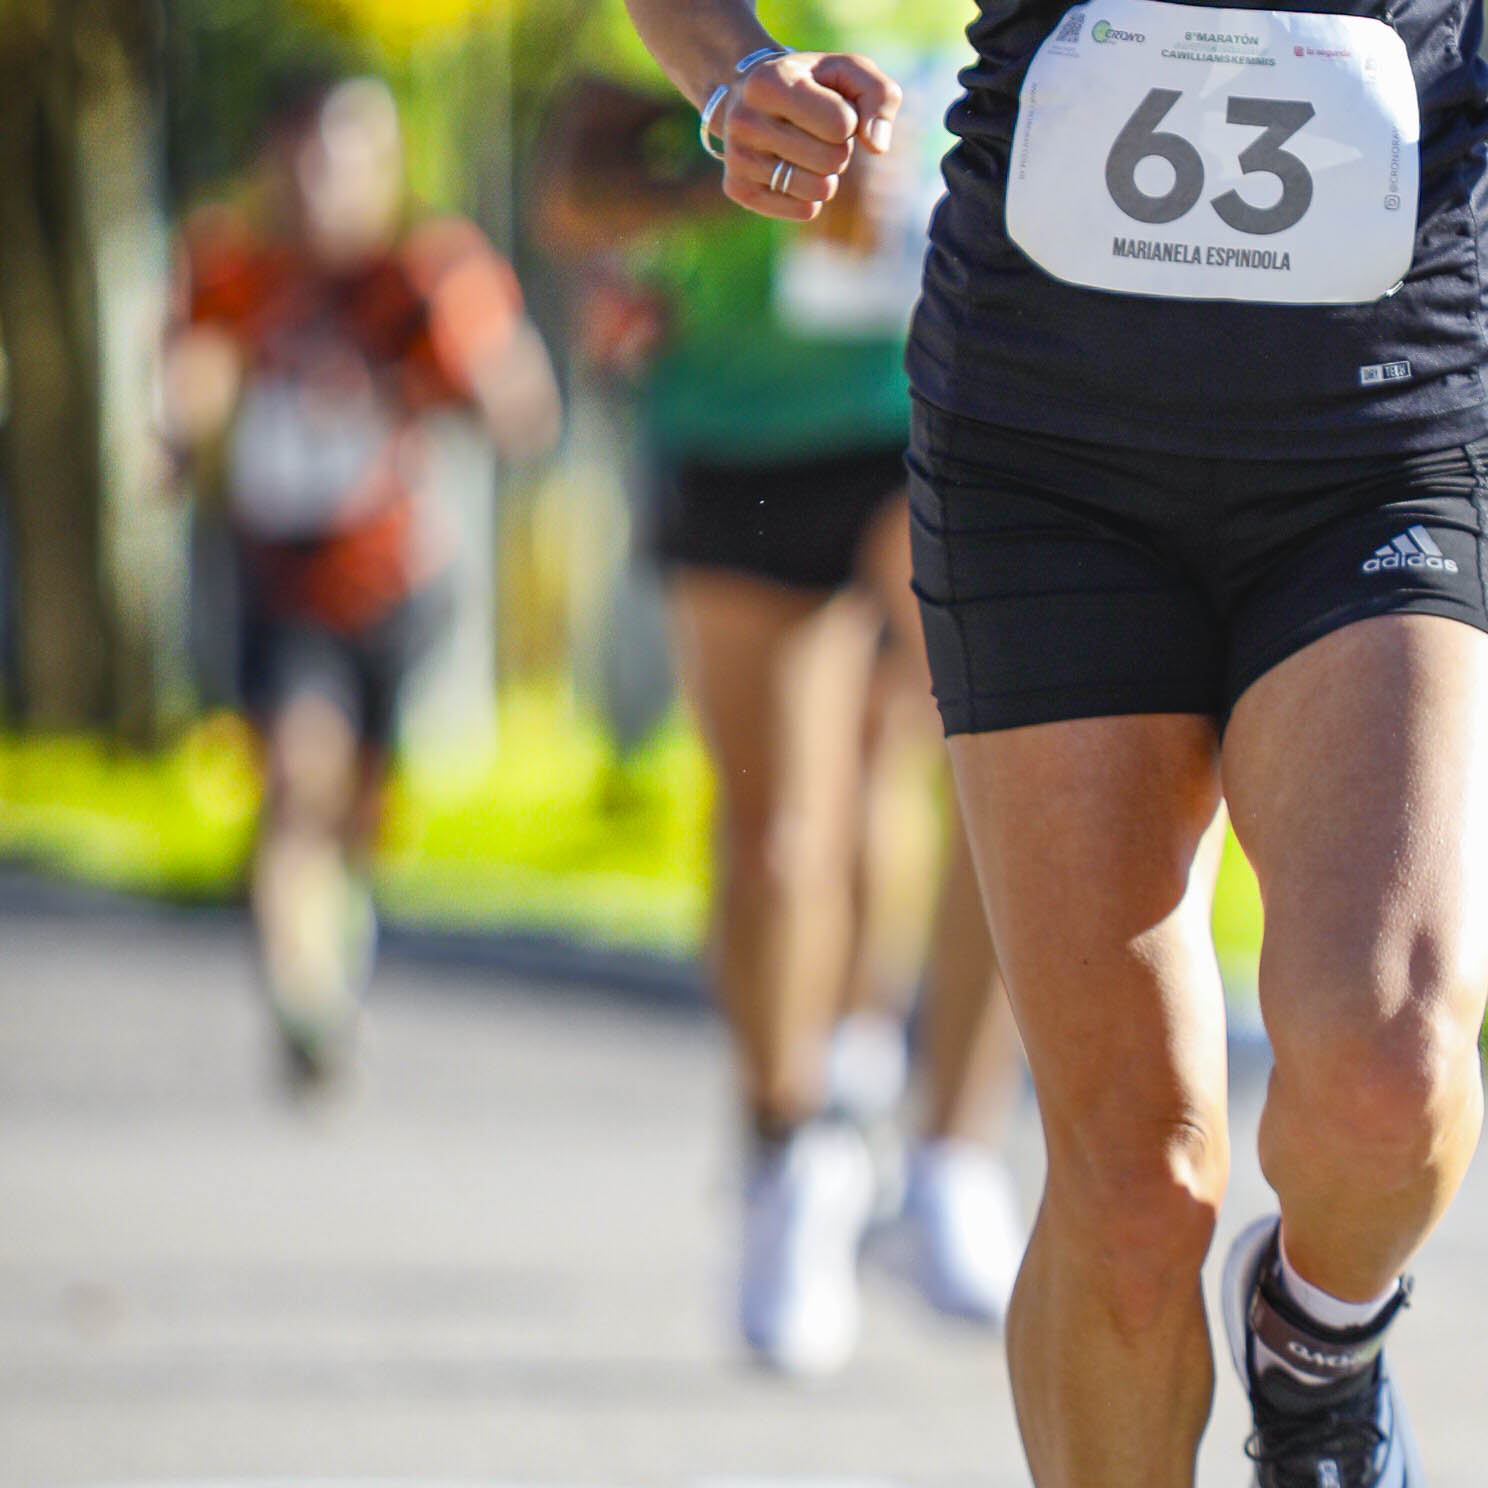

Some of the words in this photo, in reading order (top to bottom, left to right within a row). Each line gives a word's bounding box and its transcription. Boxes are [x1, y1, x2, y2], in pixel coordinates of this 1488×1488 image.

[1105, 87, 1316, 235] 63
[1112, 237, 1202, 265] MARIANELA
[1206, 246, 1291, 271] ESPINDOLA
[1362, 552, 1459, 573] adidas
